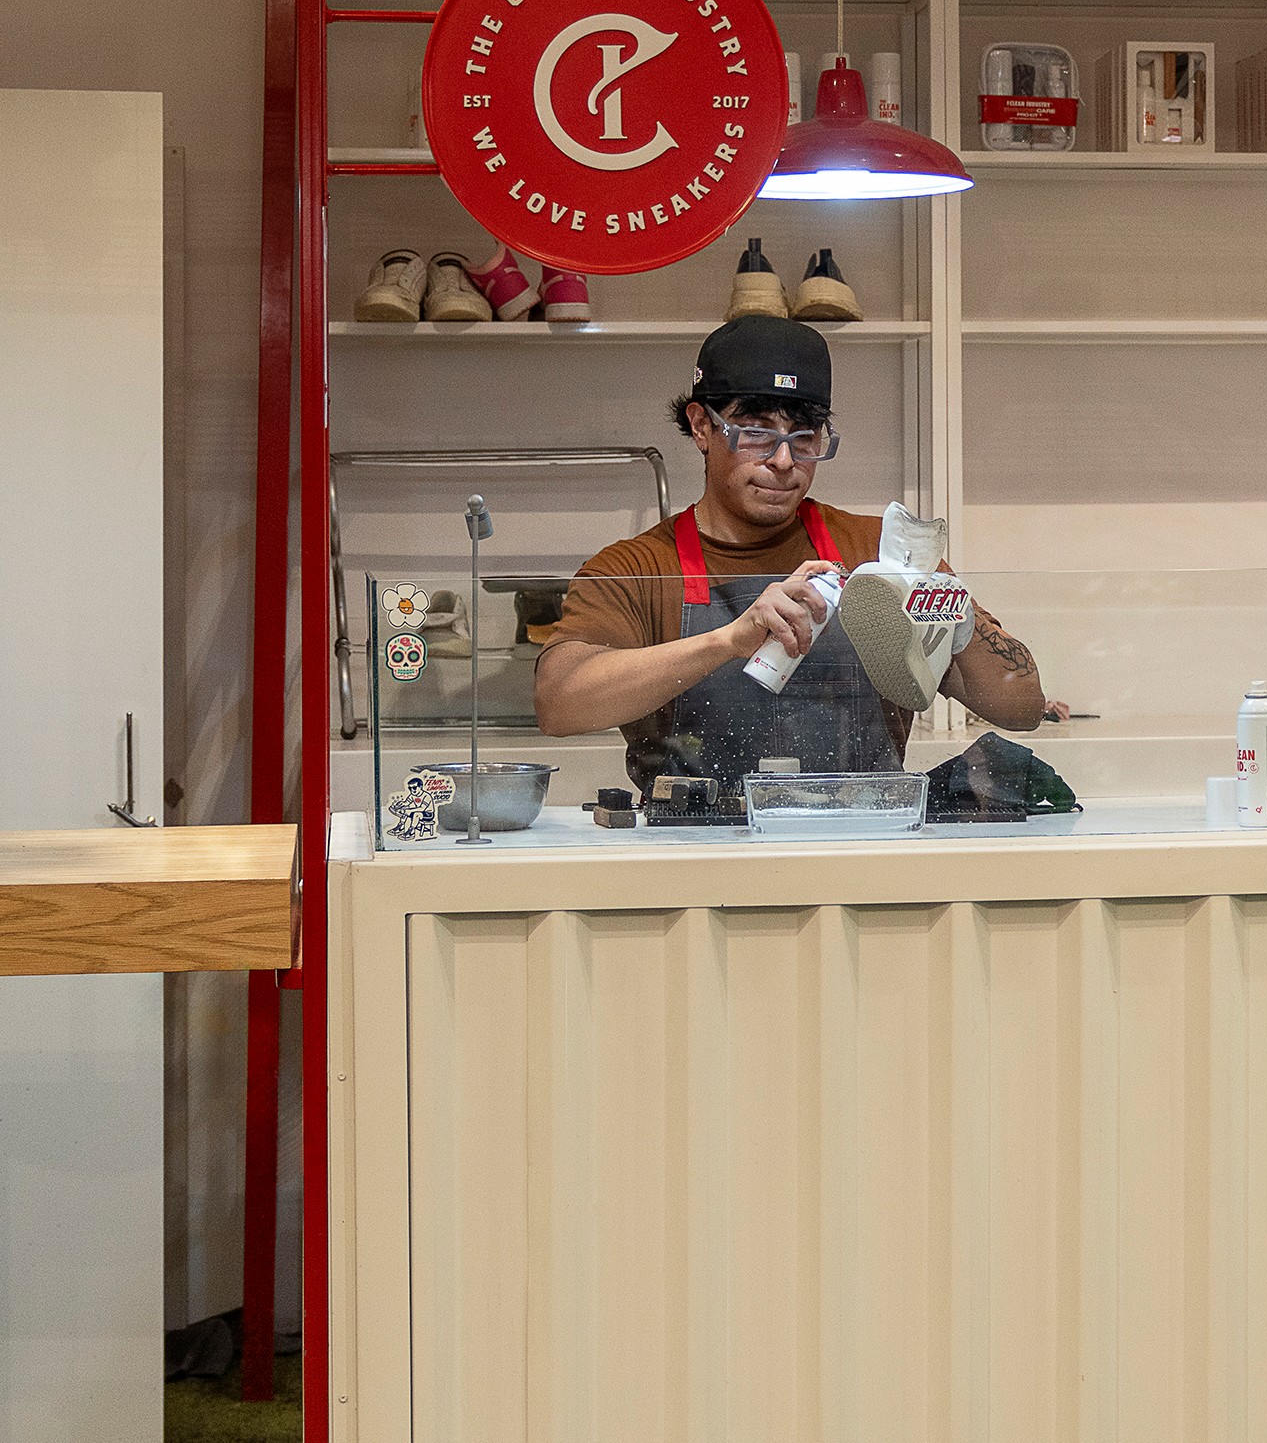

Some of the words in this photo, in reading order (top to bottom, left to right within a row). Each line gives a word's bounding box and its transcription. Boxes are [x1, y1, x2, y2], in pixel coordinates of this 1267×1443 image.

[465, 14, 504, 75] THE
[463, 95, 491, 108] EST
[712, 96, 749, 109] 2017
[473, 126, 507, 173] WE
[508, 178, 587, 231] LOVE
[606, 122, 745, 234] SNEAKERS
[906, 589, 968, 614] CLEAN
[911, 614, 957, 622] INDUSTRY
